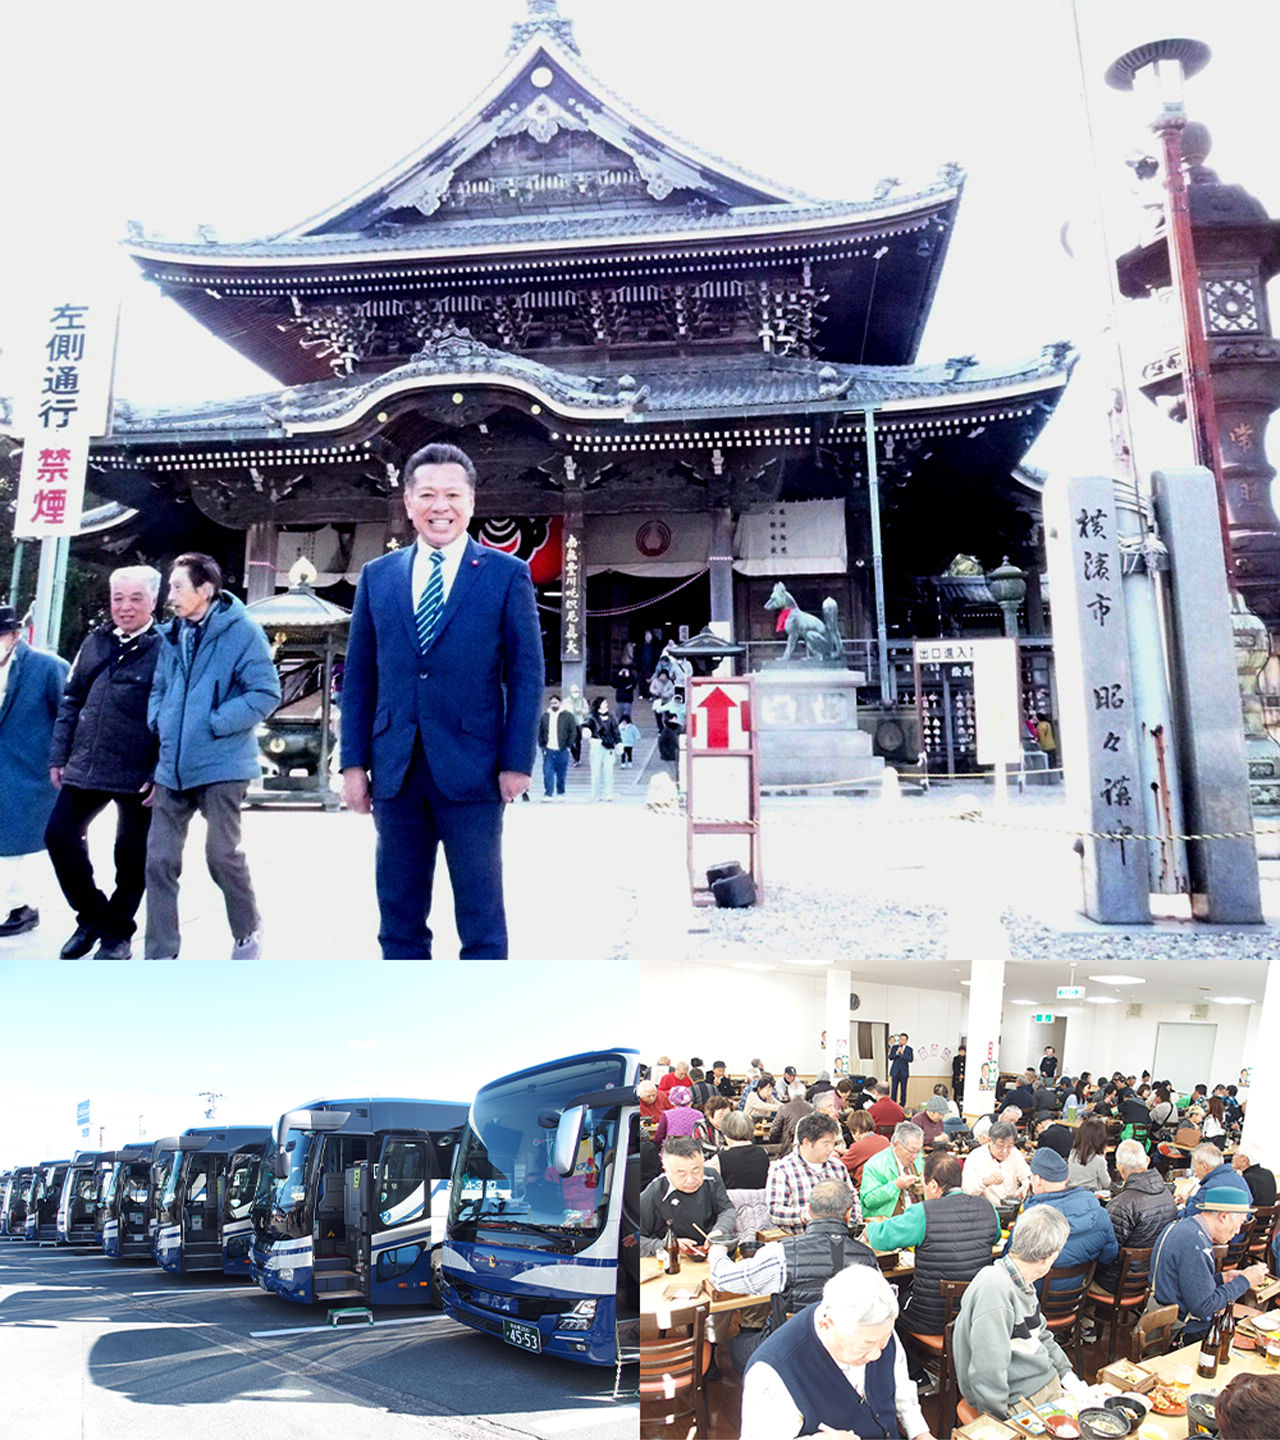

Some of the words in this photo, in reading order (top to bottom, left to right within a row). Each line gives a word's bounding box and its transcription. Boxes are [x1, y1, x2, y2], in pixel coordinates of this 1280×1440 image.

[38, 302, 89, 428] 左側通行
[30, 448, 71, 524] 禁煙
[510, 1329, 538, 1350] 45-53
